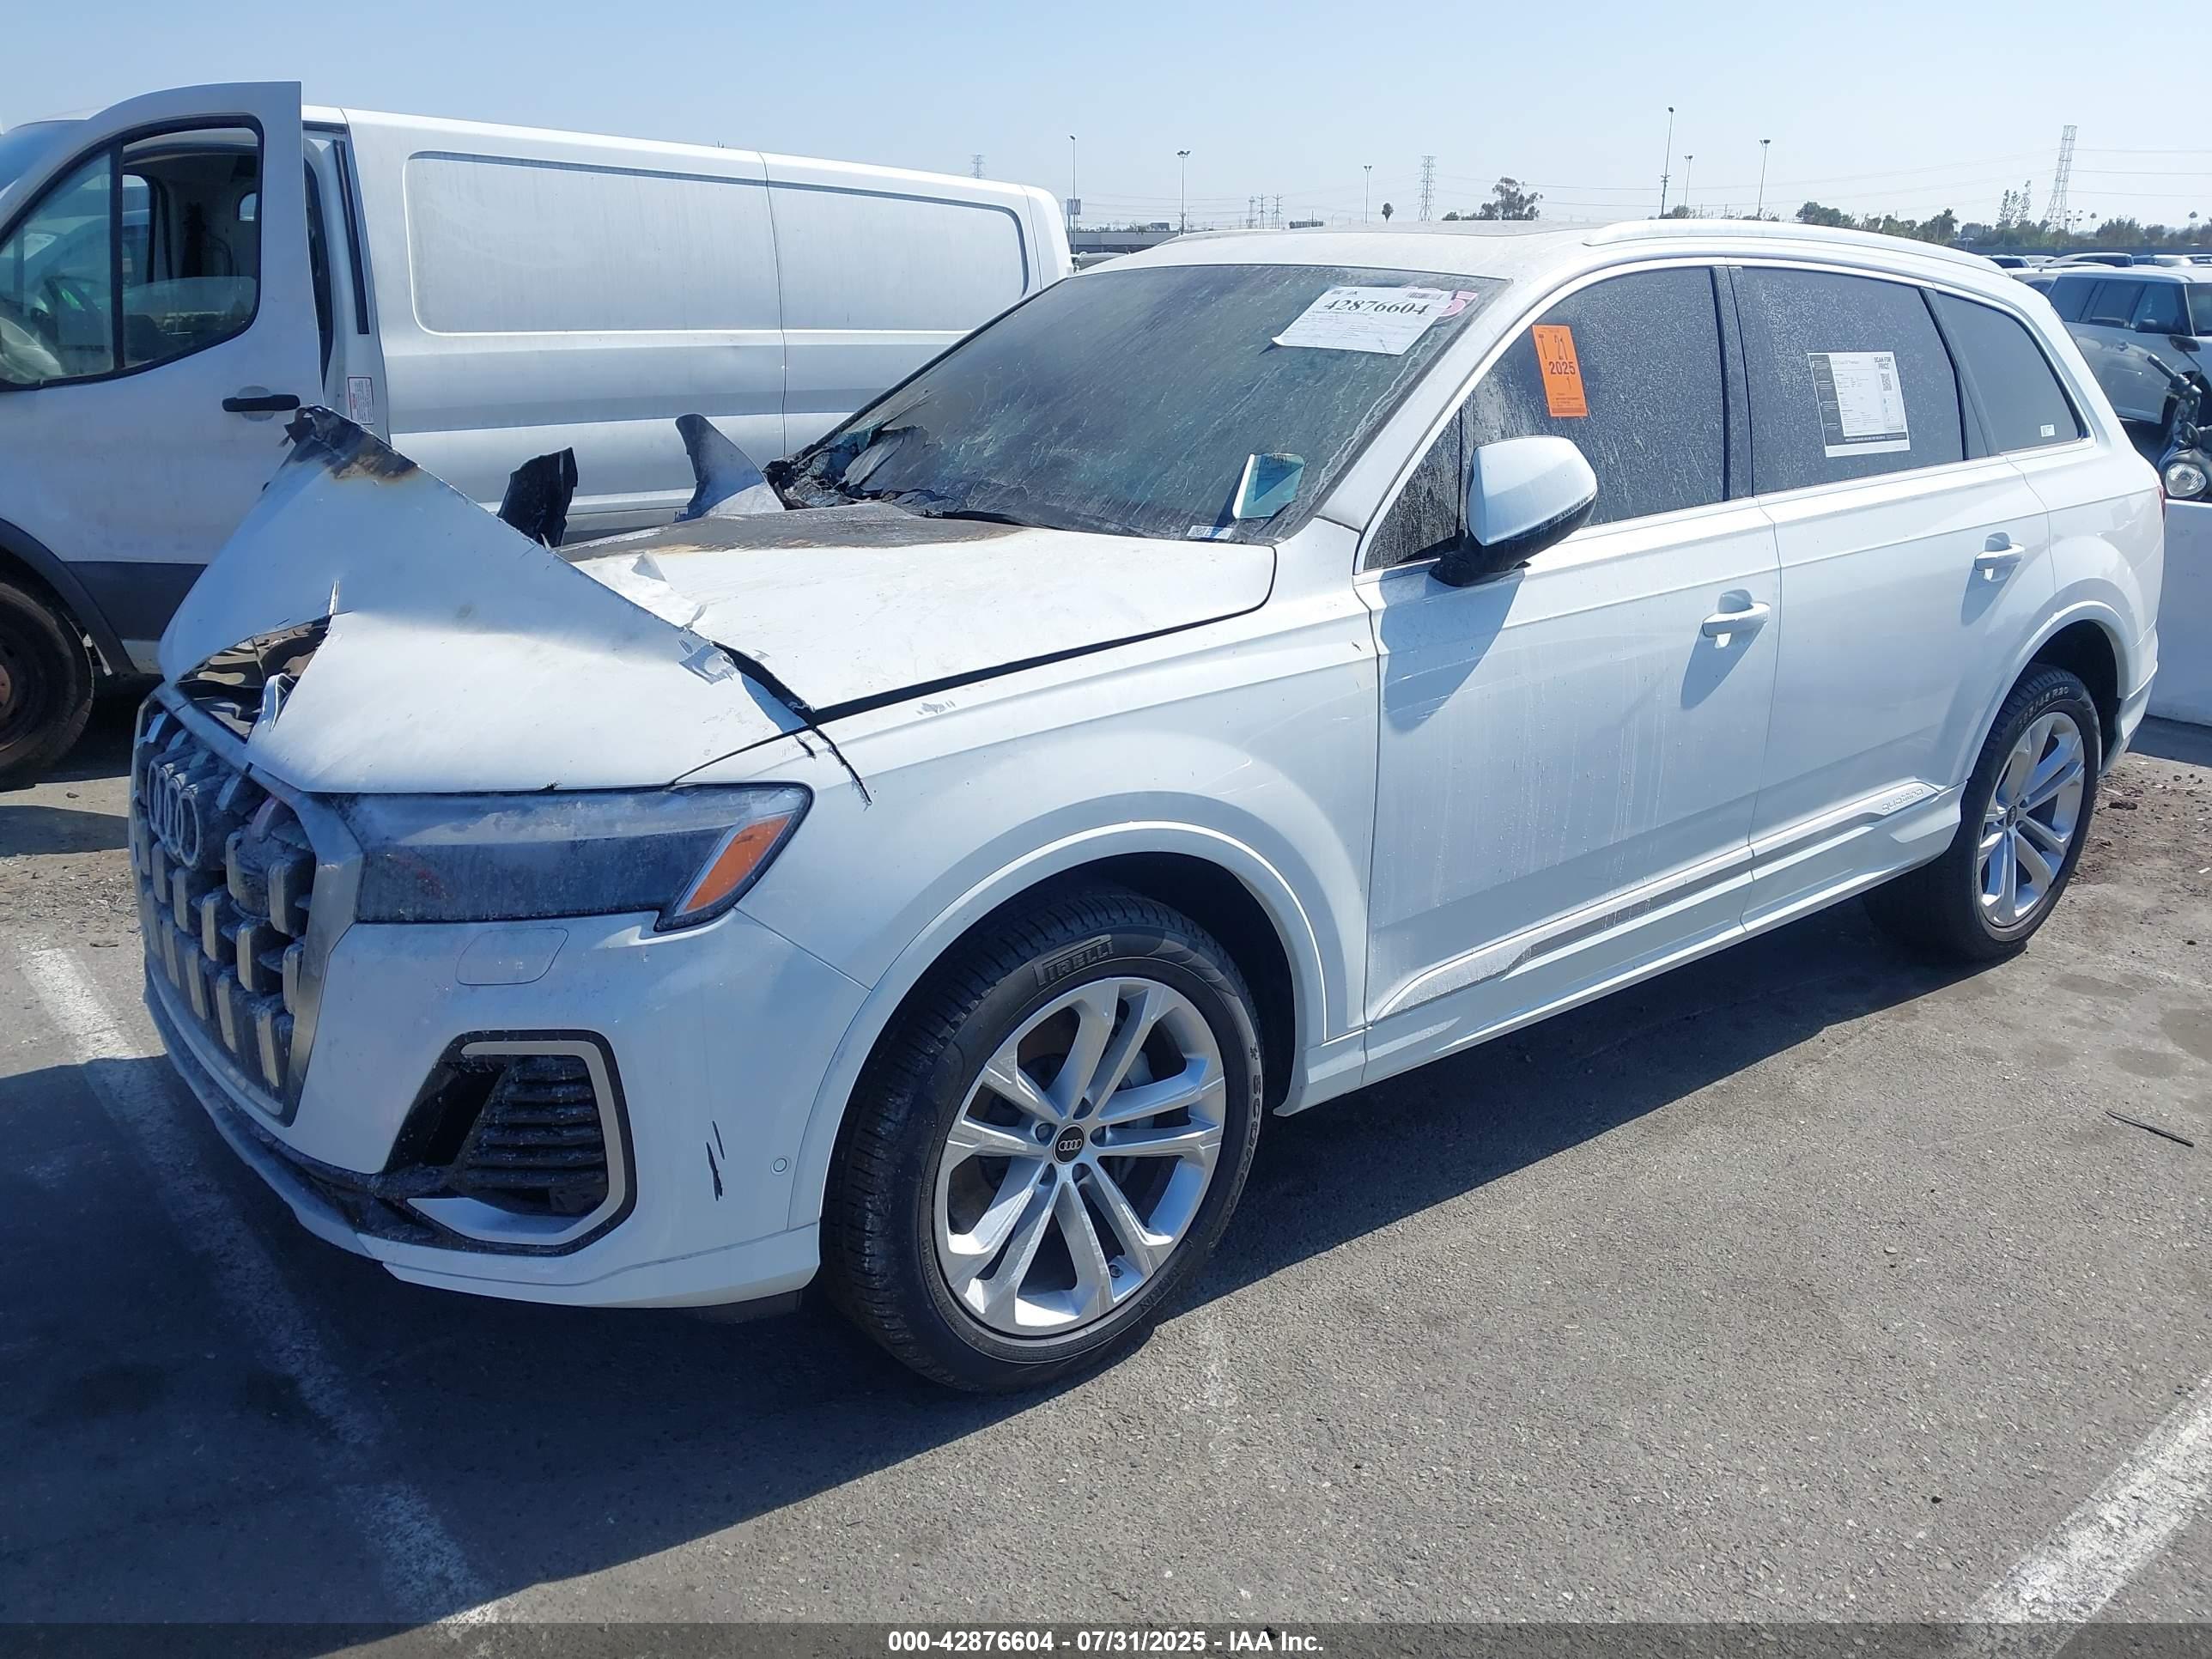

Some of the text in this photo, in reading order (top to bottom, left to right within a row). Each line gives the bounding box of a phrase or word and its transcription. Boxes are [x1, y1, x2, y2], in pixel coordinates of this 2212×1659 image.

[1323, 298, 1430, 316] 42876604
[1548, 361, 1577, 375] 2025
[1032, 933, 1114, 987] PIRELLI
